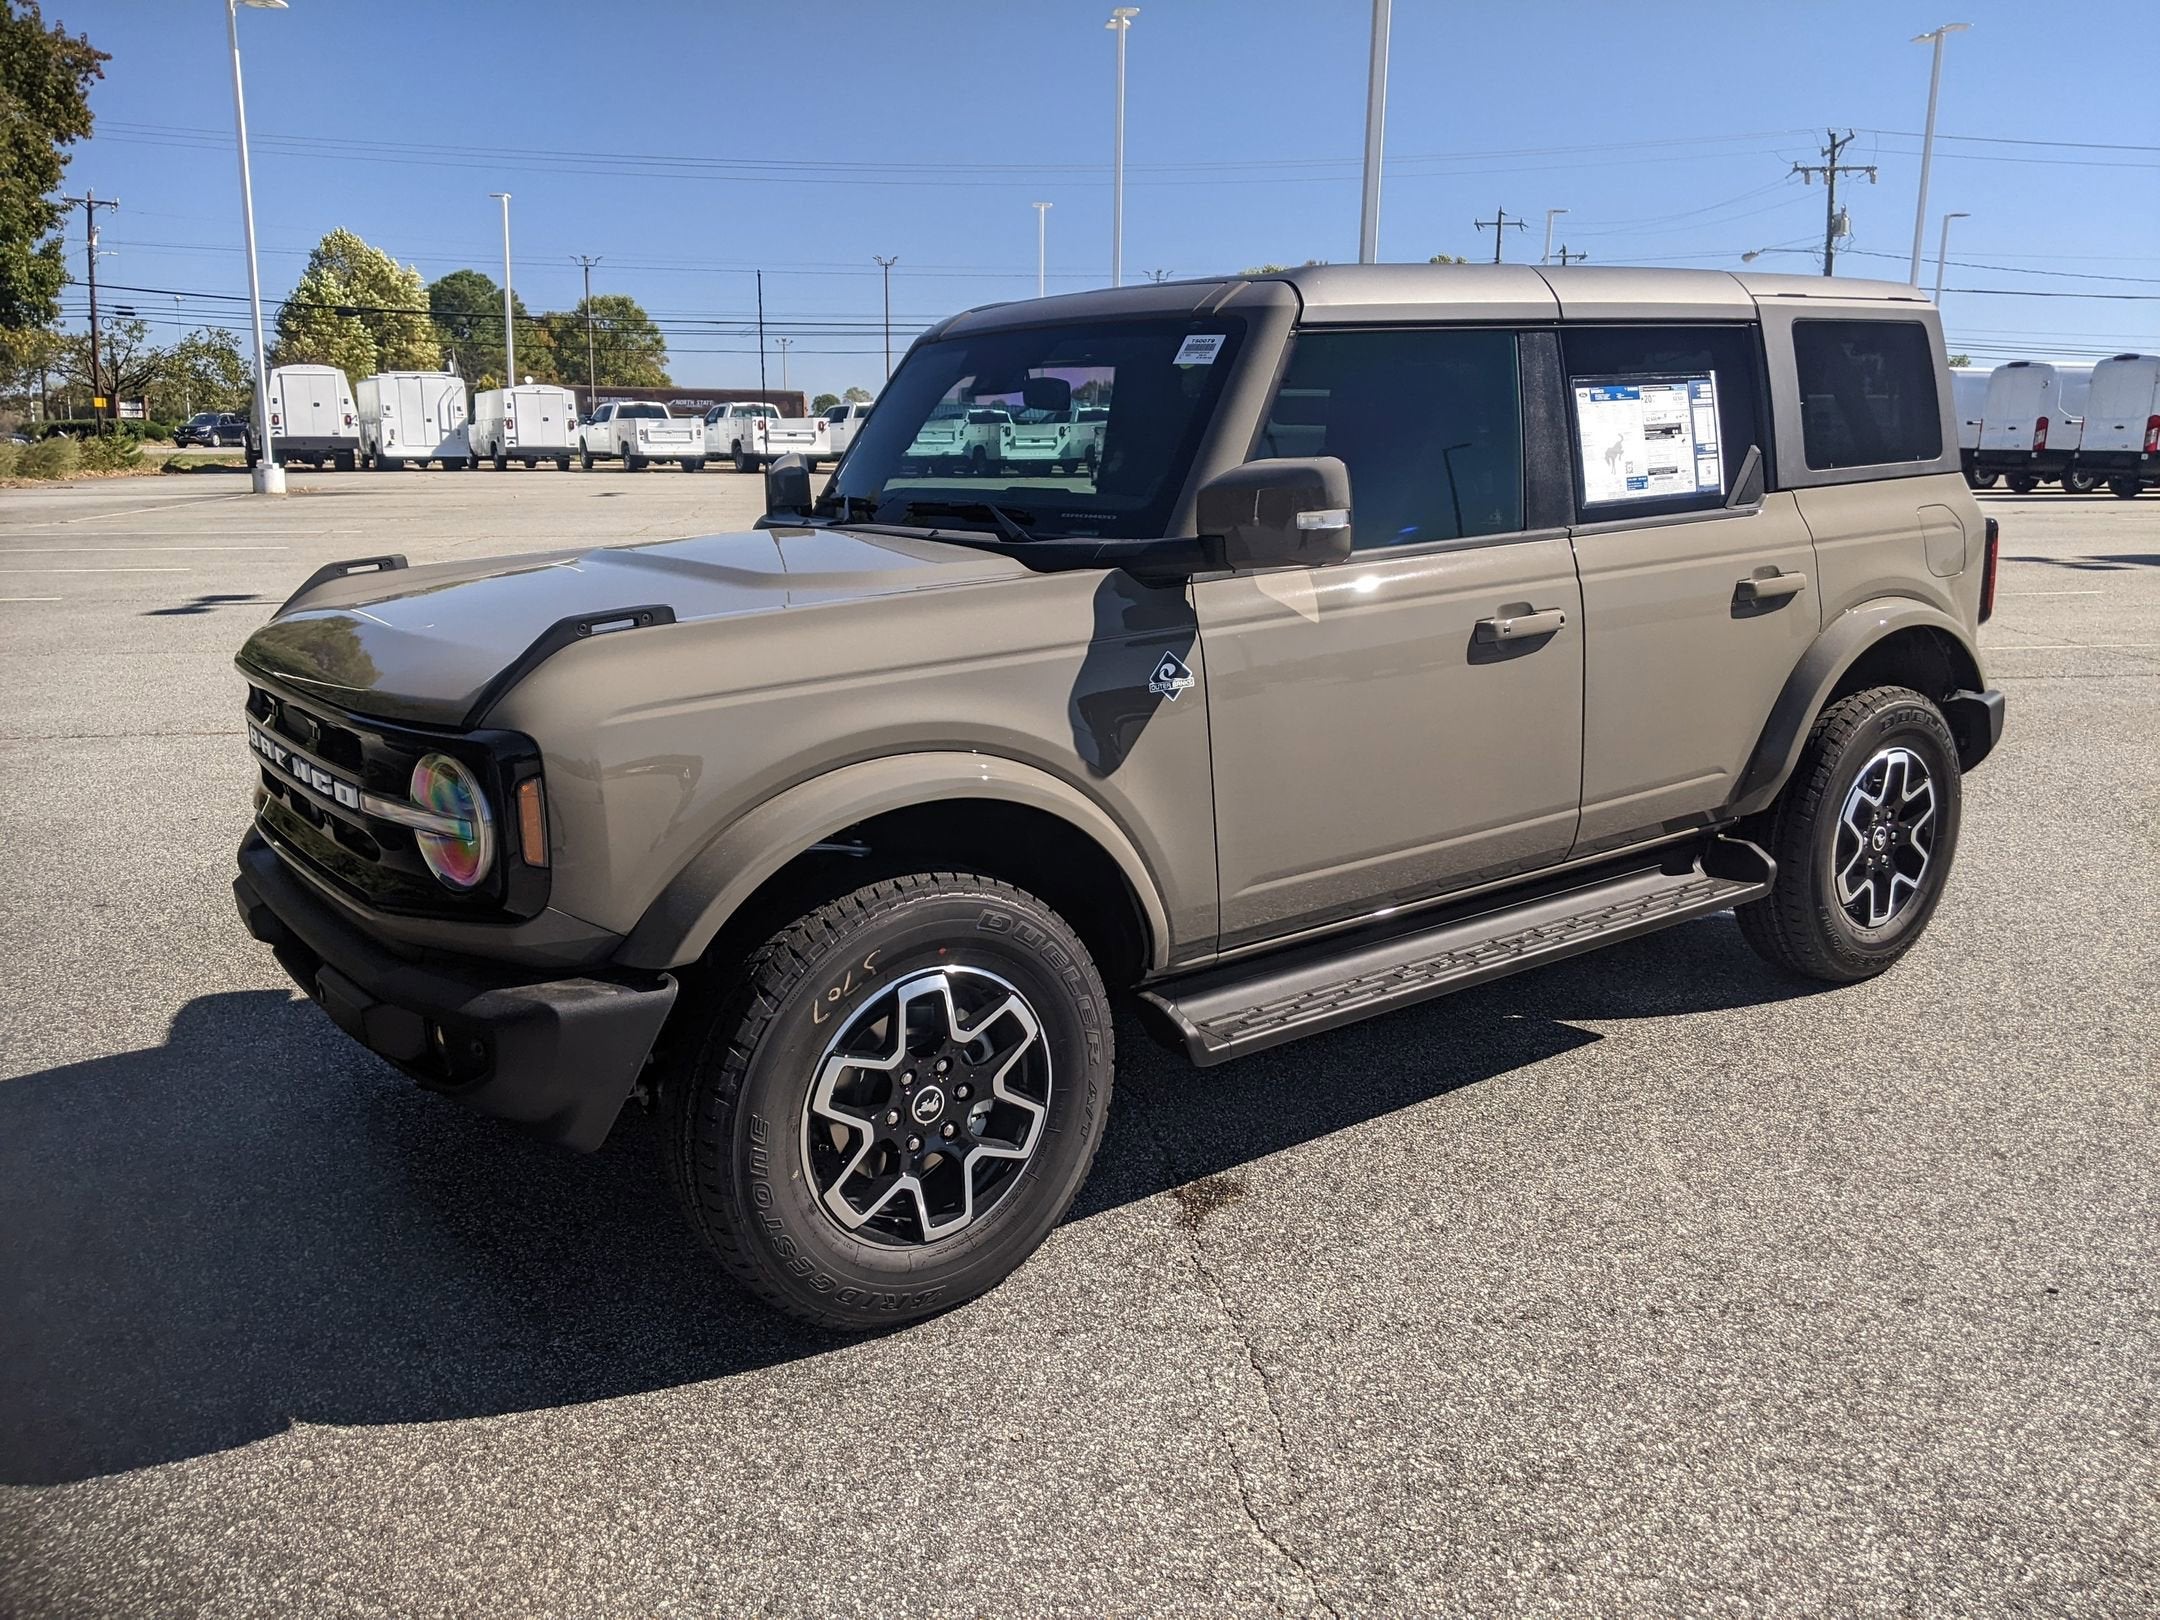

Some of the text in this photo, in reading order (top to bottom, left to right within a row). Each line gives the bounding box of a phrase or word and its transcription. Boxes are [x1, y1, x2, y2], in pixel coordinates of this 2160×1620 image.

[1060, 512, 1117, 520] BRONCO
[1151, 681, 1172, 691] OUTER
[977, 908, 1101, 1067] DUELER
